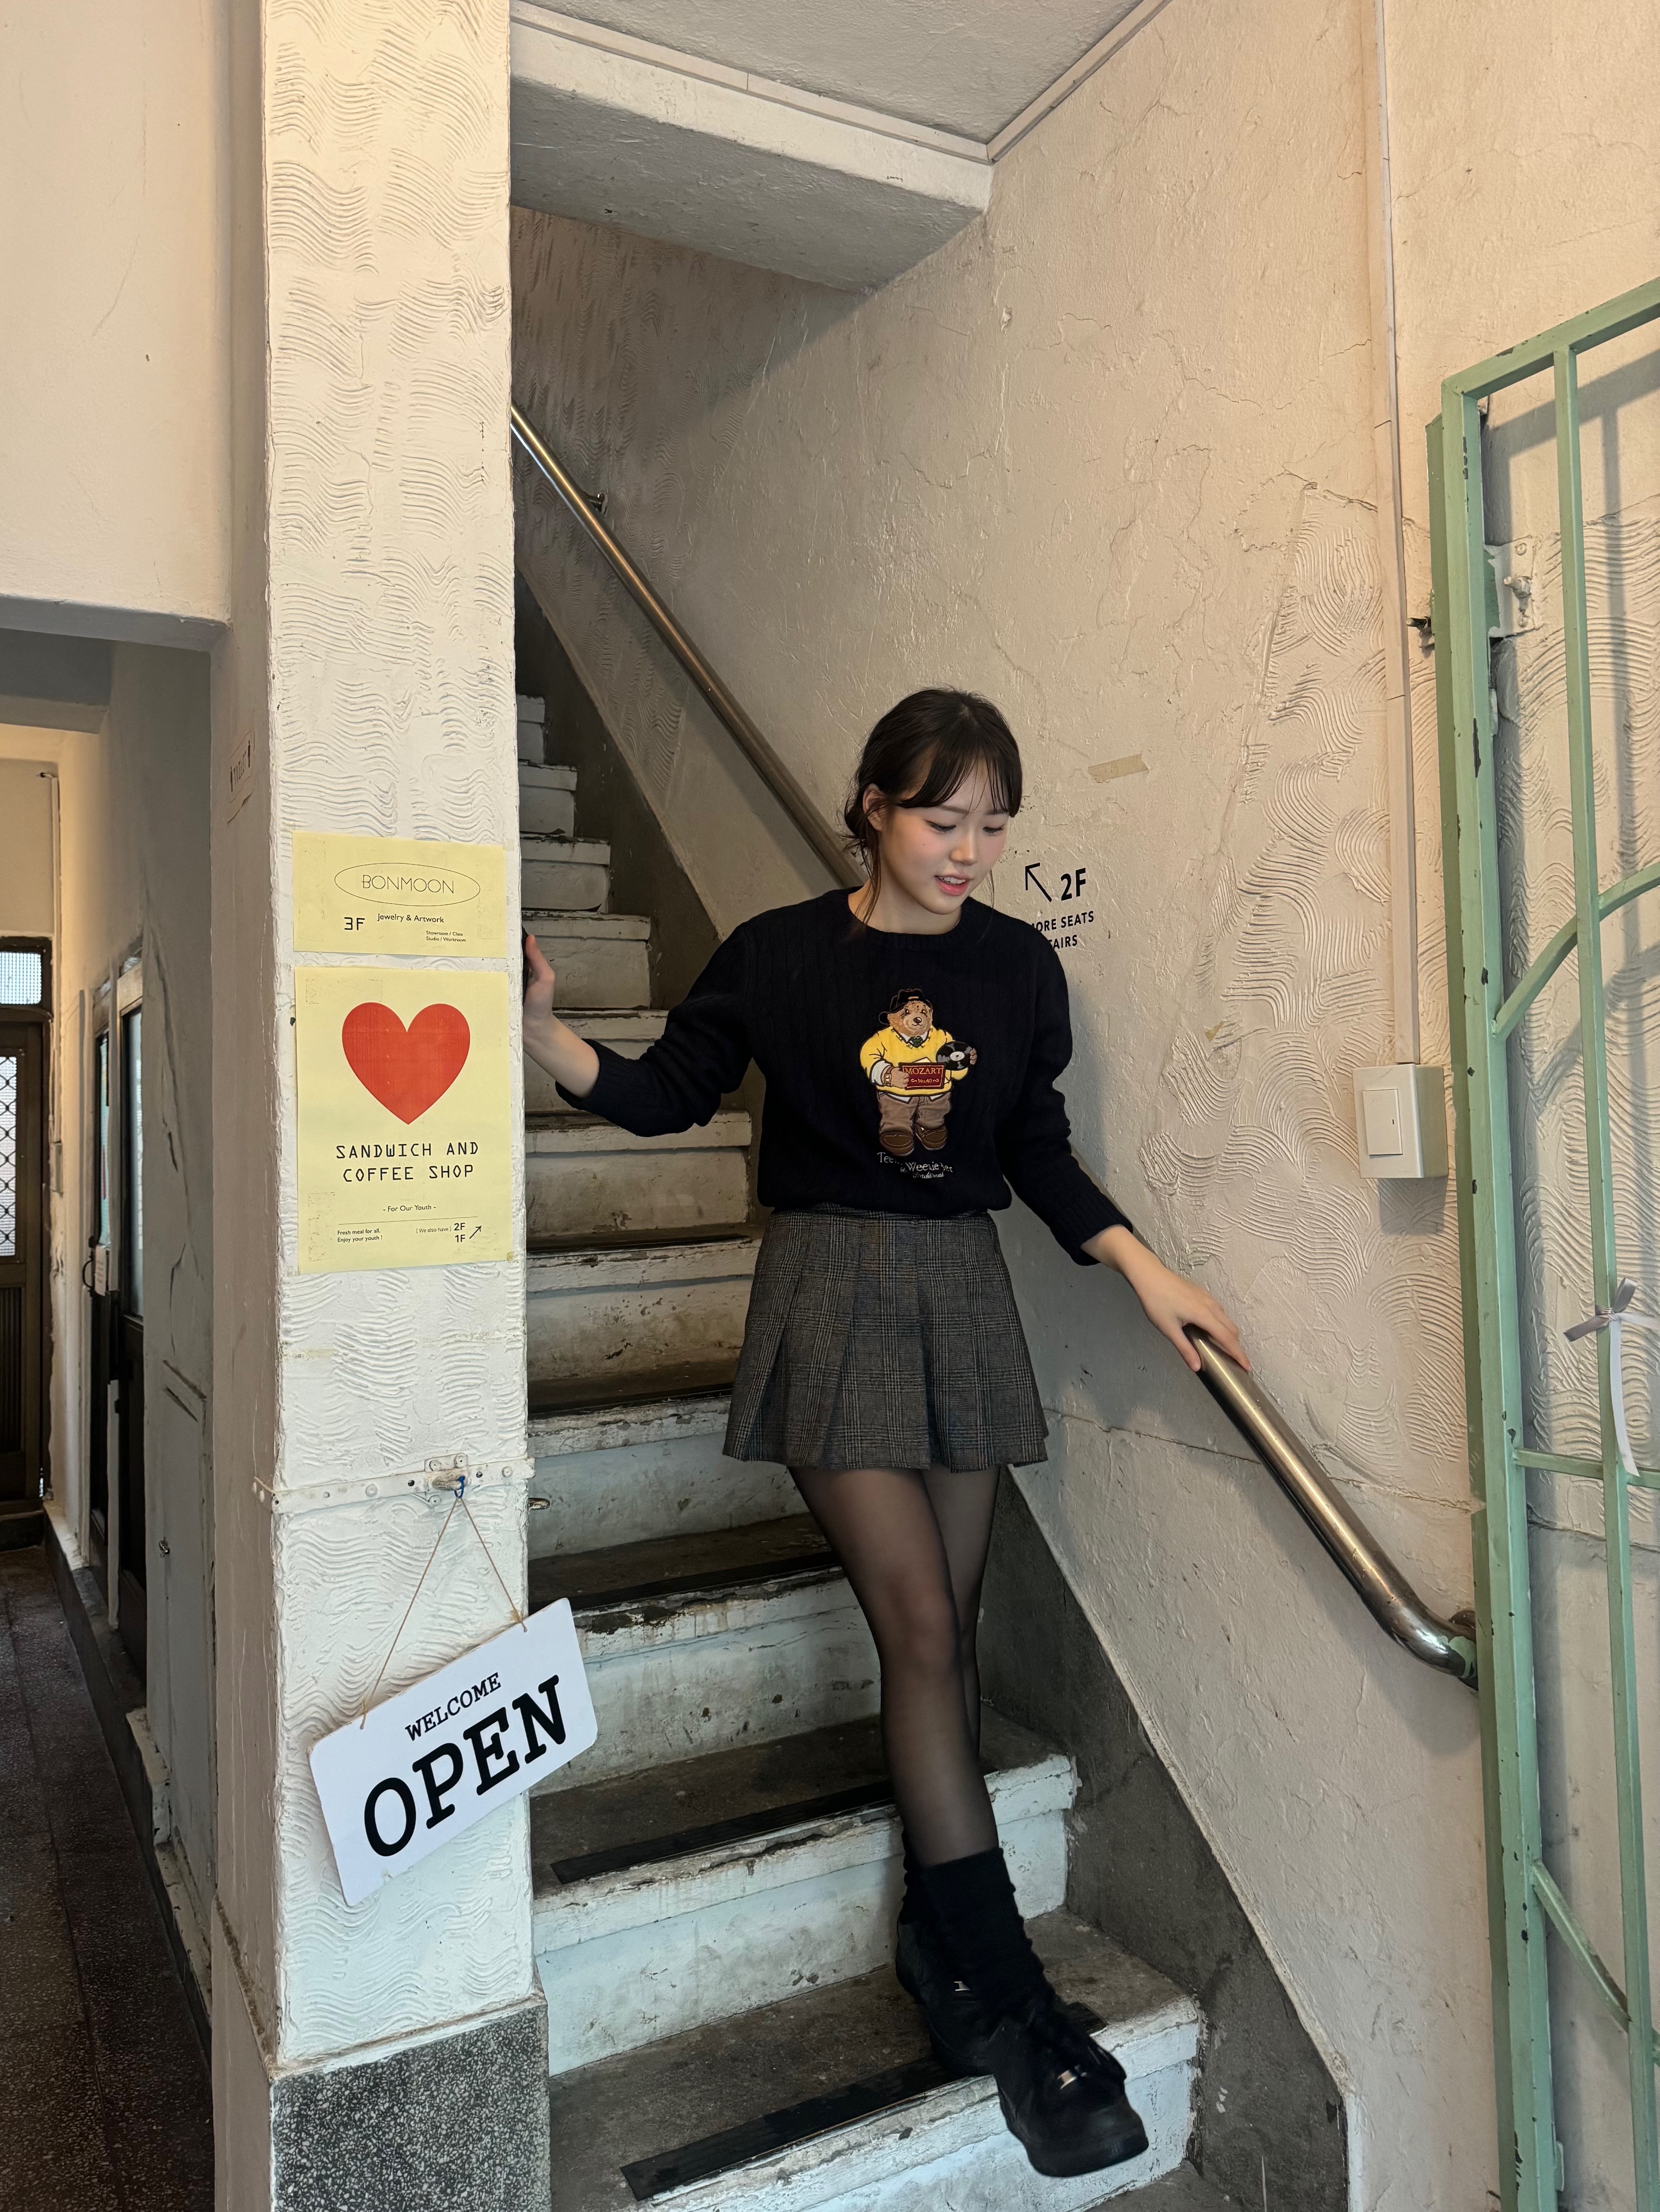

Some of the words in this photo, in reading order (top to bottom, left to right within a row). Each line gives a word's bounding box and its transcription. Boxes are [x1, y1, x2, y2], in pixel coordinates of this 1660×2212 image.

[361, 874, 454, 894] BONMOON
[1060, 867, 1086, 901] 2F
[344, 916, 365, 931] 3F
[377, 913, 404, 922] Jewelry
[414, 915, 444, 923] Artwork
[1031, 918, 1057, 932] ORE
[1061, 910, 1094, 928] SEATS
[1047, 934, 1077, 949] AIRS
[336, 1143, 432, 1159] SANDWICH
[446, 1142, 479, 1156] AND
[342, 1166, 414, 1182] COFFEE
[429, 1164, 474, 1179] SHOP
[454, 1222, 465, 1231] 2F
[455, 1234, 465, 1243] 1F
[404, 1672, 502, 1741] WELCOME
[364, 1674, 566, 1857] OPEN
